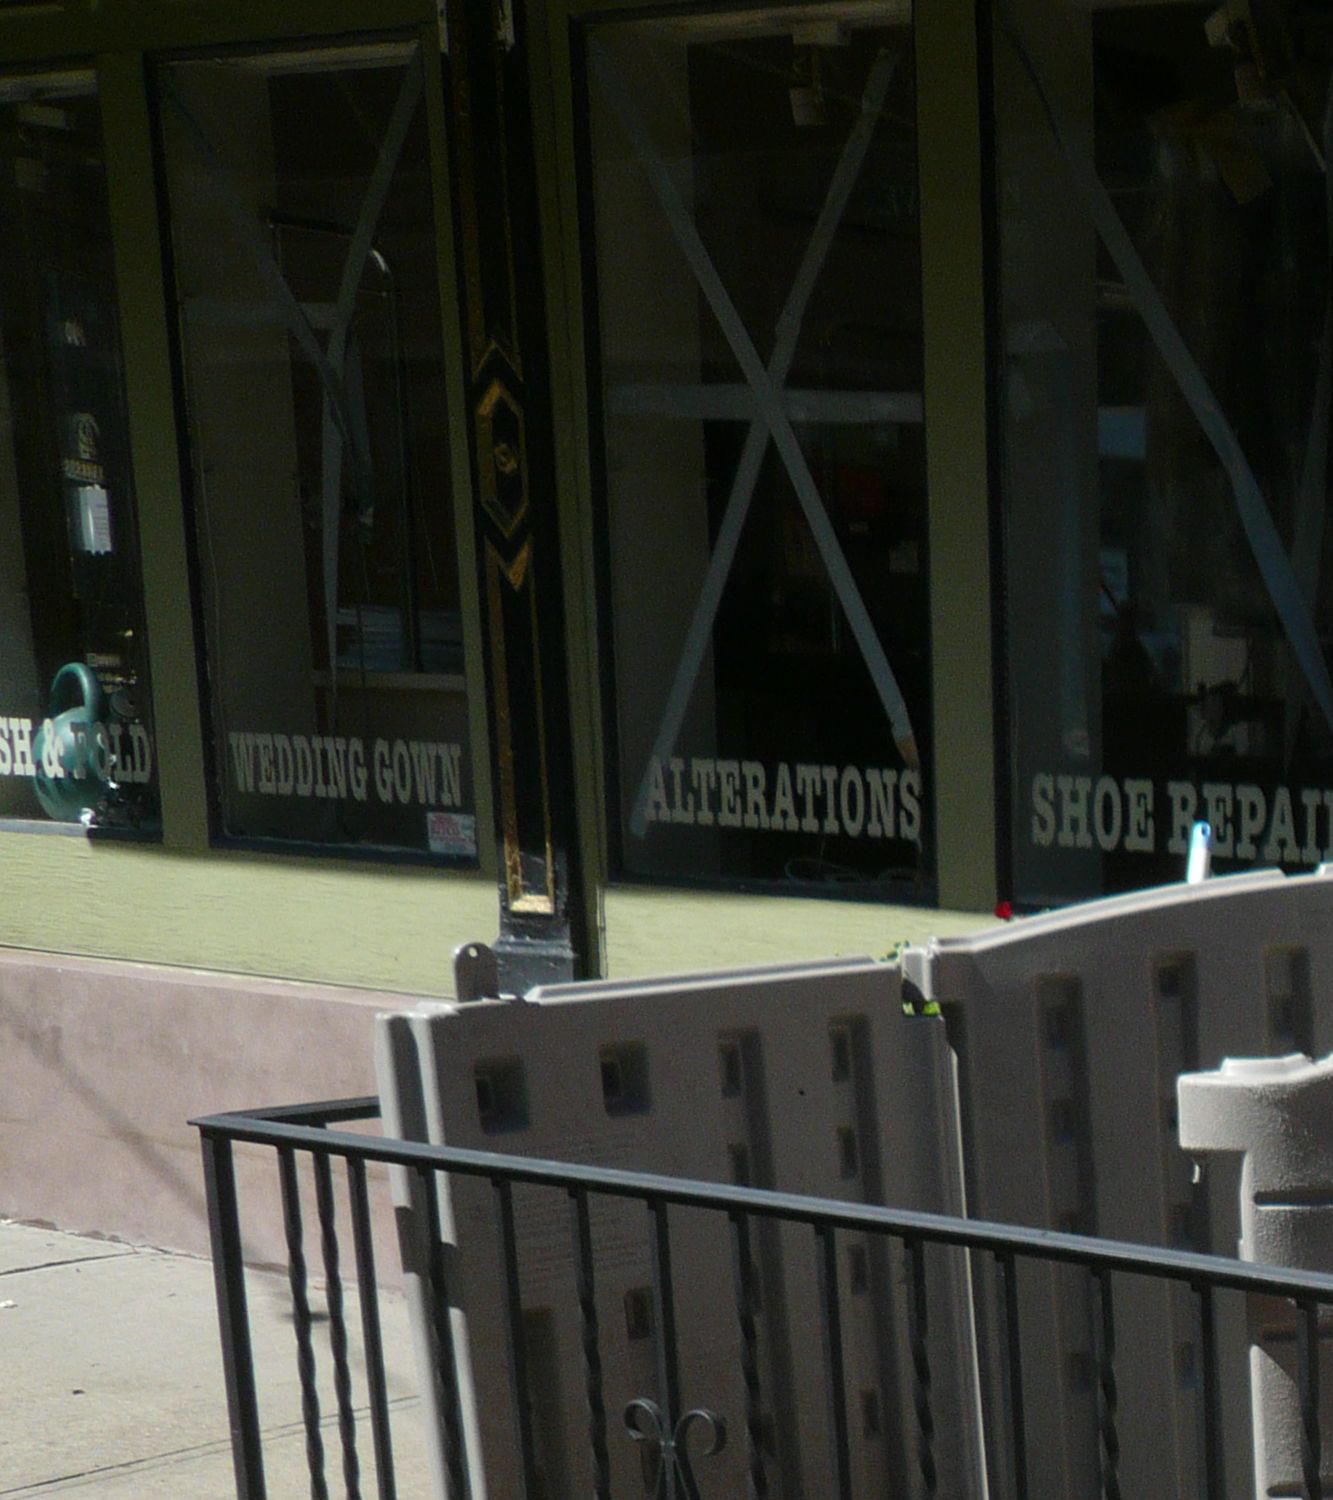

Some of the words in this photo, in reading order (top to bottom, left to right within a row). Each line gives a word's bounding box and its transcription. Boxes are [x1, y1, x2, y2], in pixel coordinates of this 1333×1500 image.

[42, 718, 64, 778] &
[70, 722, 151, 783] FOLD
[229, 732, 367, 801] WEDDING
[374, 737, 461, 807] GOWN
[645, 755, 921, 842] ALTERATIONS
[1031, 772, 1155, 851] SHOE
